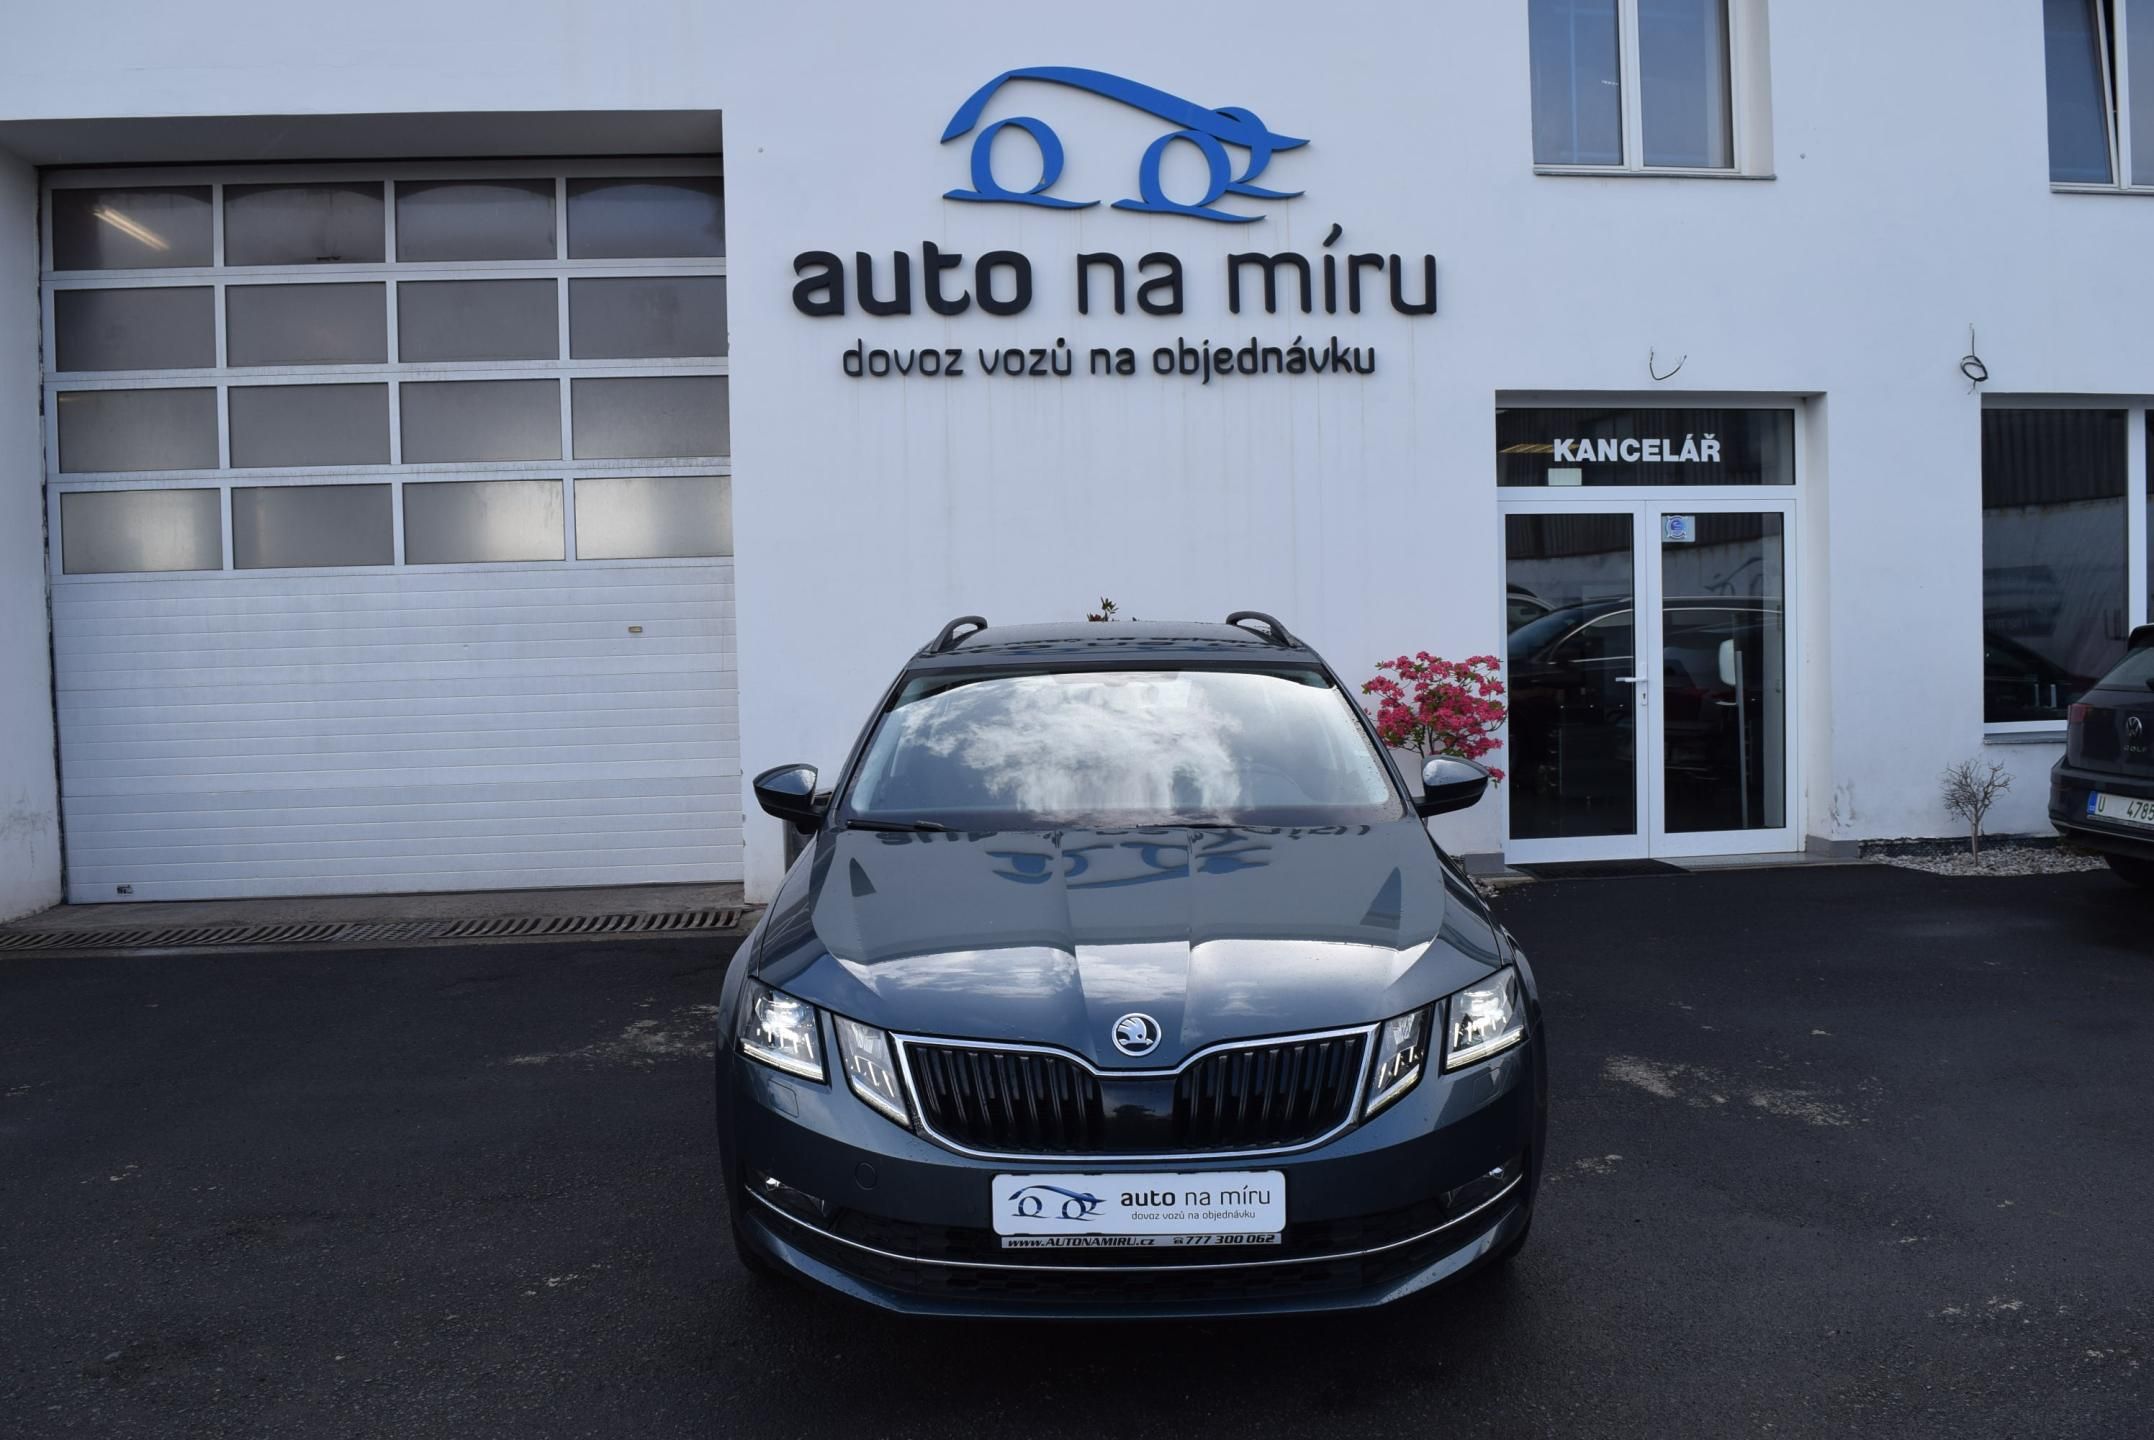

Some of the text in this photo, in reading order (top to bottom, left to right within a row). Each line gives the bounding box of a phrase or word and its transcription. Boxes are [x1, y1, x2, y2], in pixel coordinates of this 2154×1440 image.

[791, 223, 1437, 317] auto na míru
[842, 335, 1376, 385] dovoz vozů na objednávku
[1553, 433, 1721, 463] KANCELÁŘ
[1120, 1185, 1270, 1207] auto na míru
[1131, 1210, 1256, 1221] dovoz vozů na objednávku
[1184, 1235, 1212, 1245] 777
[1214, 1235, 1243, 1244] 300
